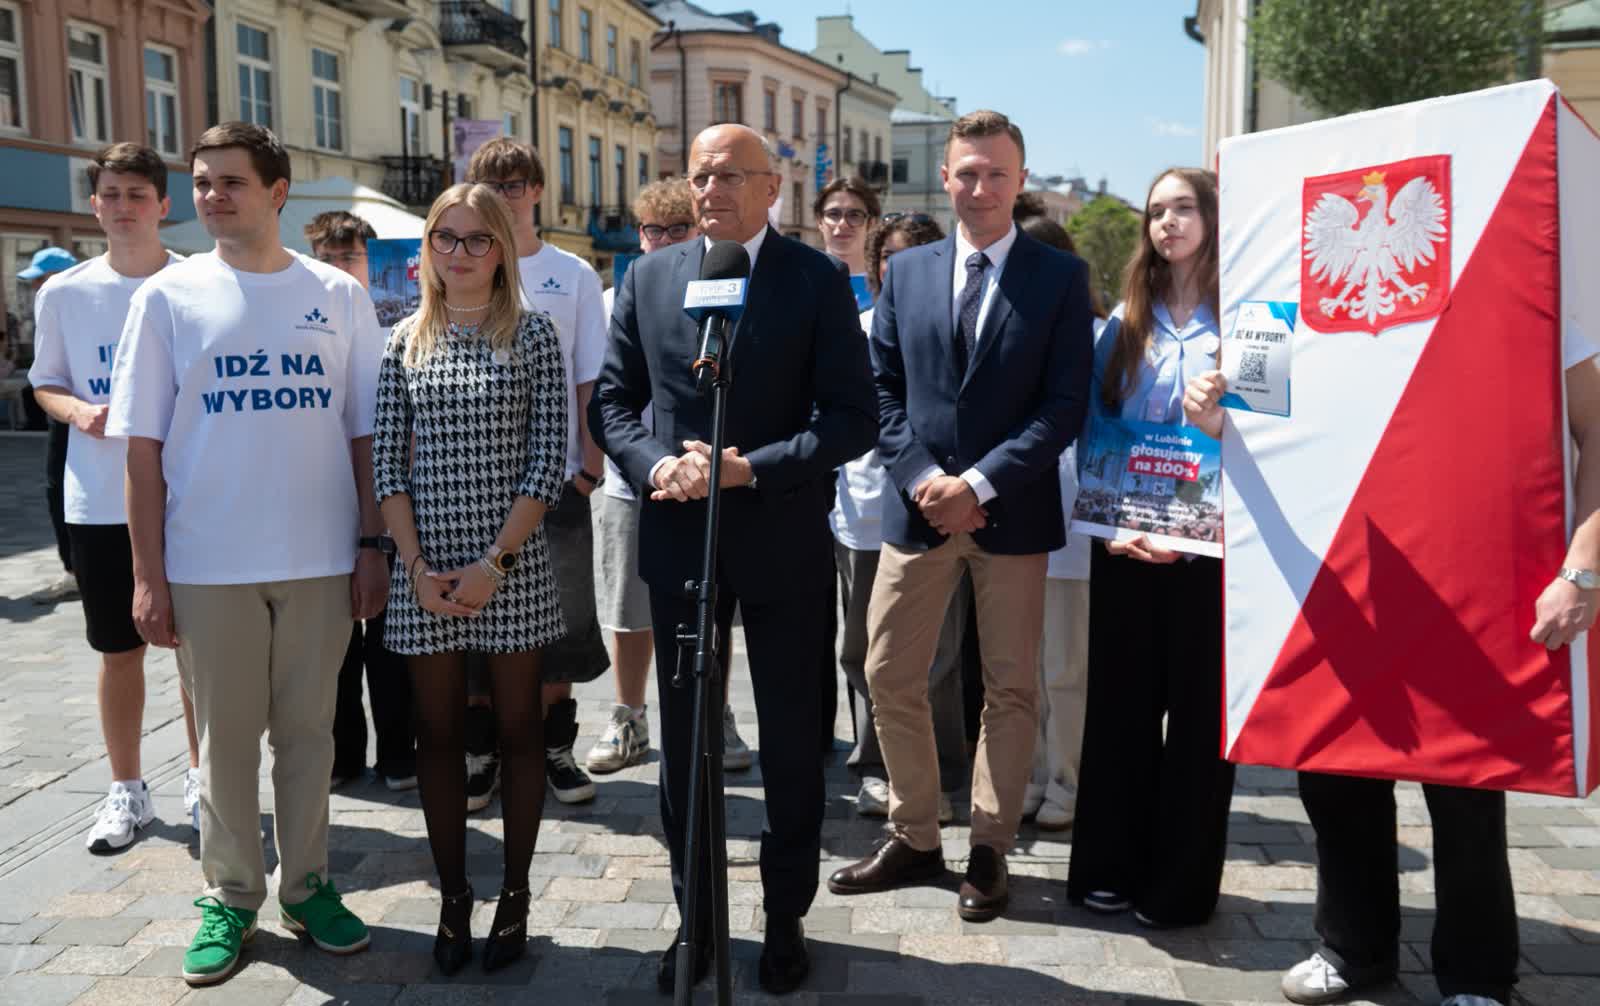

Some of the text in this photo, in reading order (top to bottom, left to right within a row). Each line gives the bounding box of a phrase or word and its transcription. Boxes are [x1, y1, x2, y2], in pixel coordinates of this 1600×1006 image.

[728, 282, 737, 293] 3
[214, 348, 325, 378] IDŹ NA
[201, 386, 332, 414] WYBORY
[1155, 433, 1193, 447] Lublinie
[1130, 442, 1204, 466] głosujemy
[1135, 460, 1195, 478] na 100%
